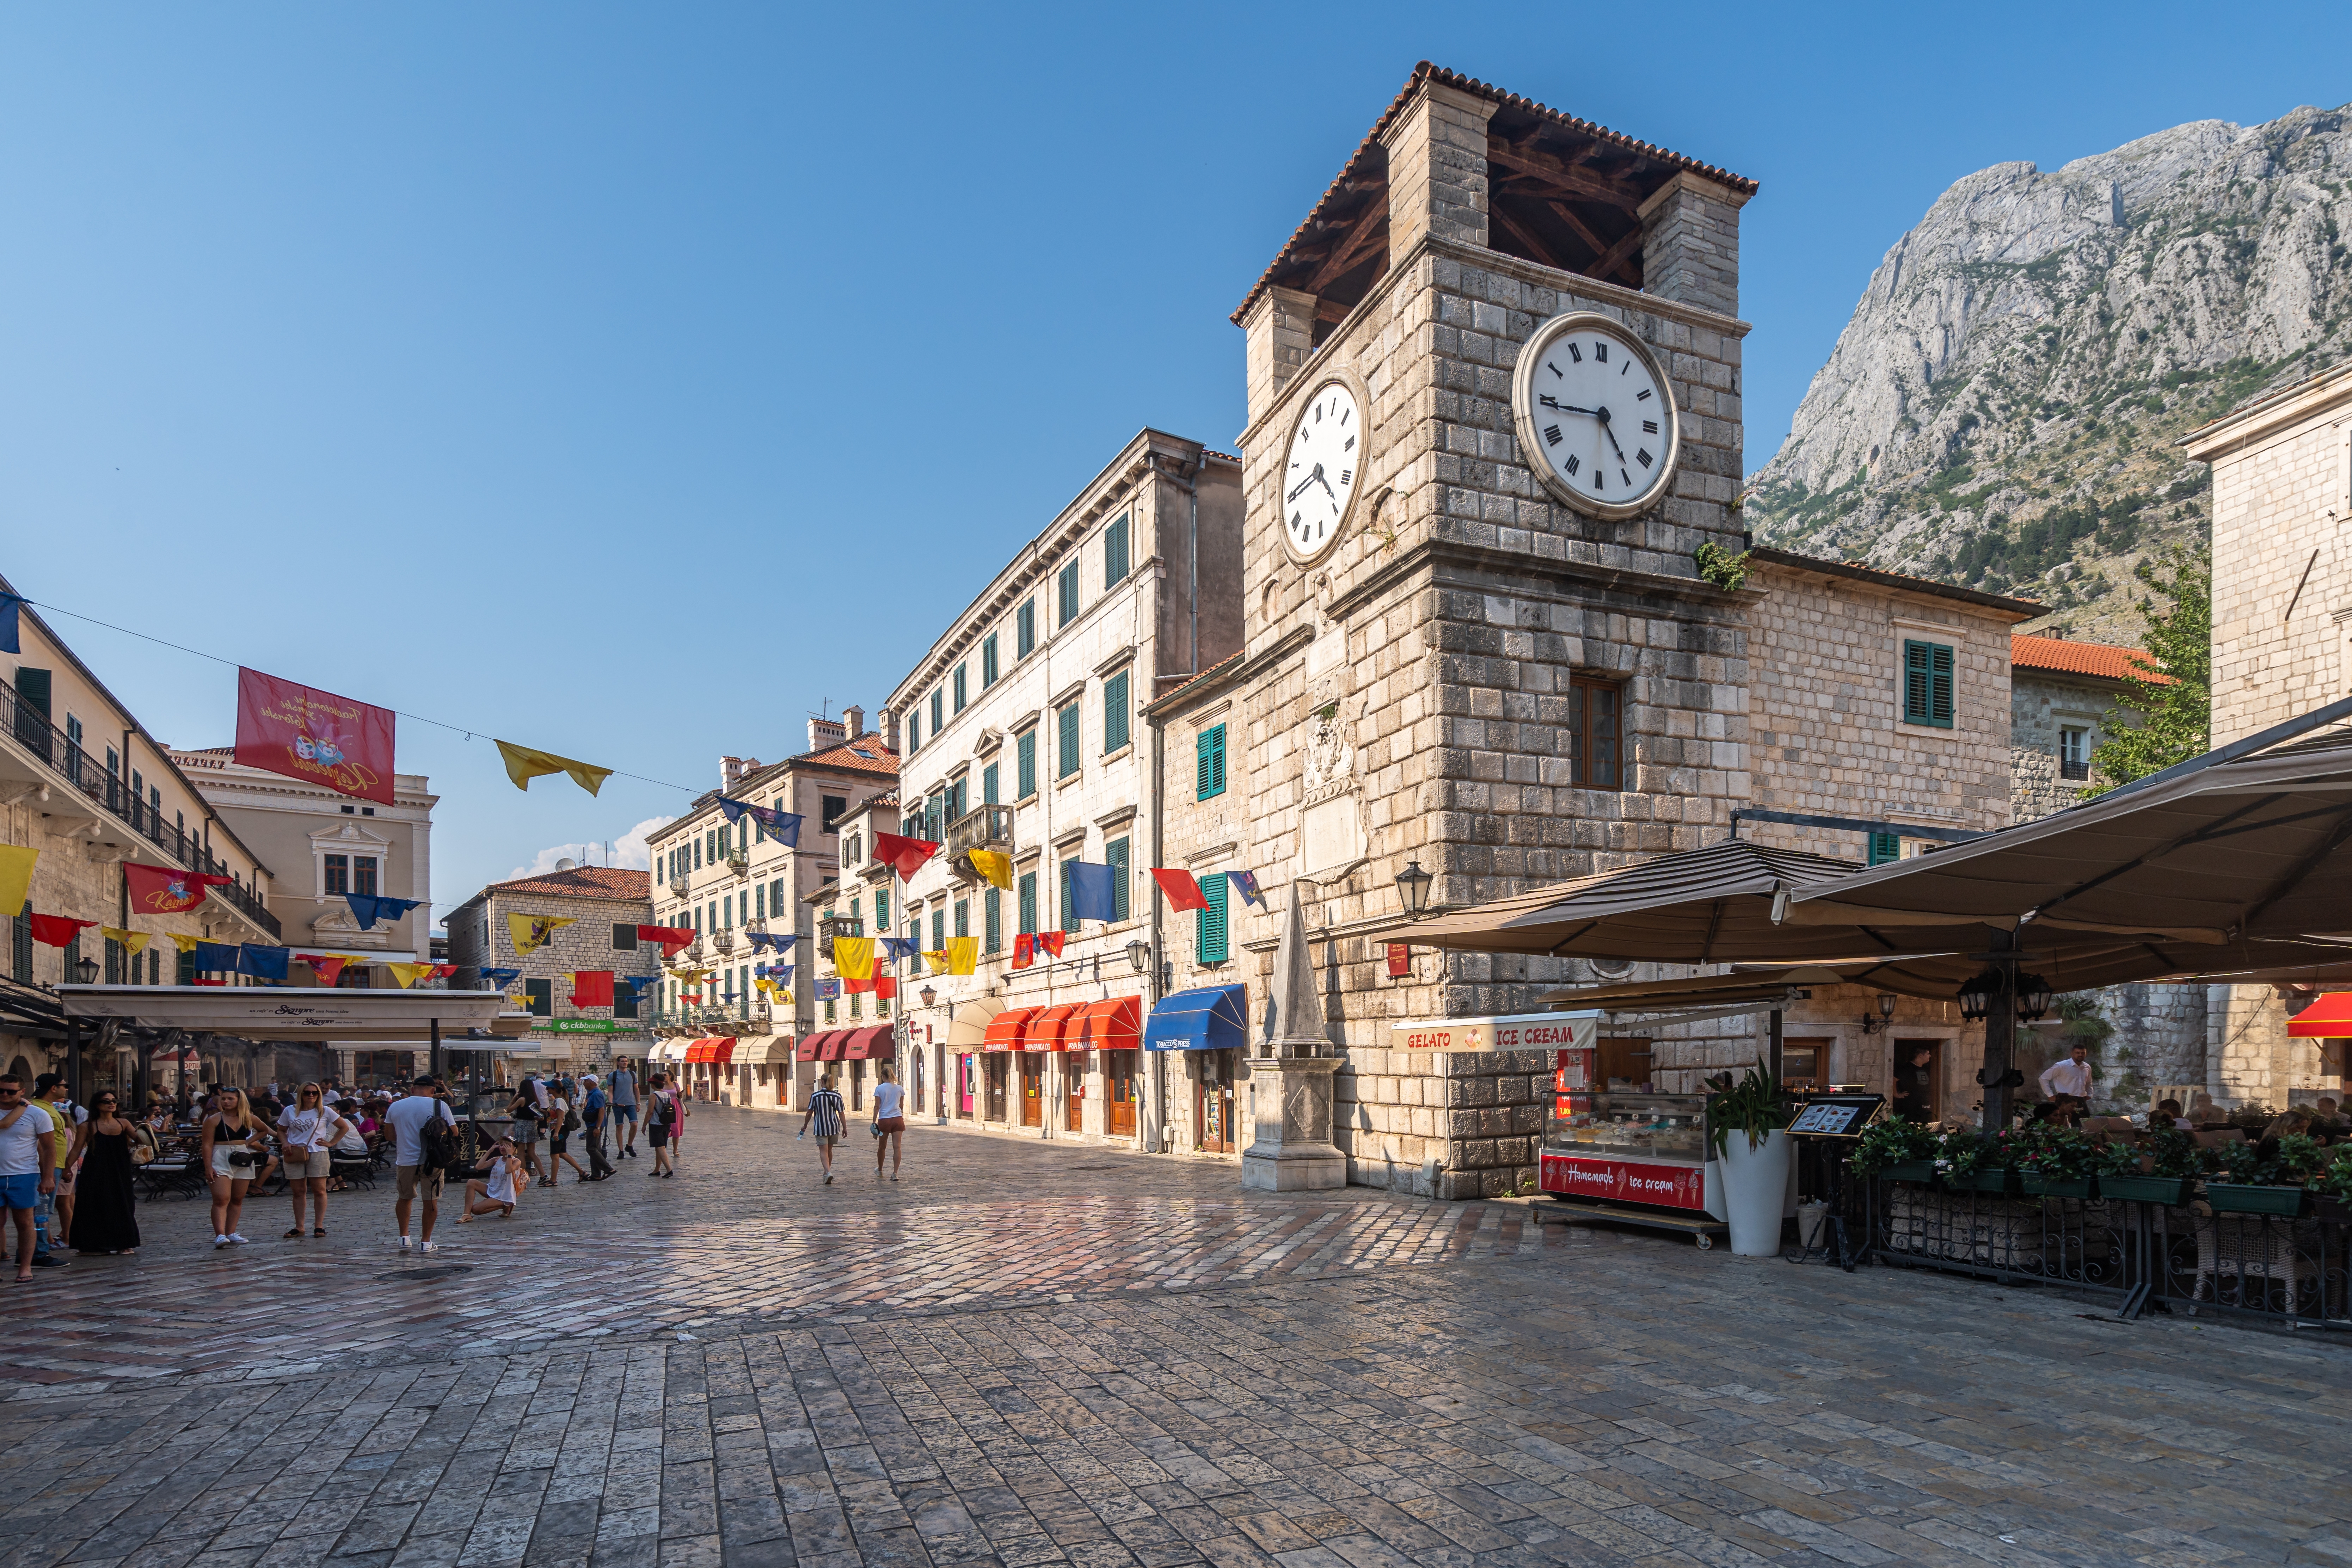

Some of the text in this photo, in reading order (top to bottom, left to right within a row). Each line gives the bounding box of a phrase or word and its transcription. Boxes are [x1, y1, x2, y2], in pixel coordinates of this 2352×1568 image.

[275, 1004, 315, 1015] Siempre
[301, 1017, 334, 1026] Siempre
[1408, 1026, 1574, 1048] GELATO ICE CREAM
[1068, 1042, 1077, 1050] PRVA
[1091, 1040, 1098, 1049] CG
[295, 1121, 314, 1133] VITA
[1568, 1164, 1673, 1194] Homemade ice cream
